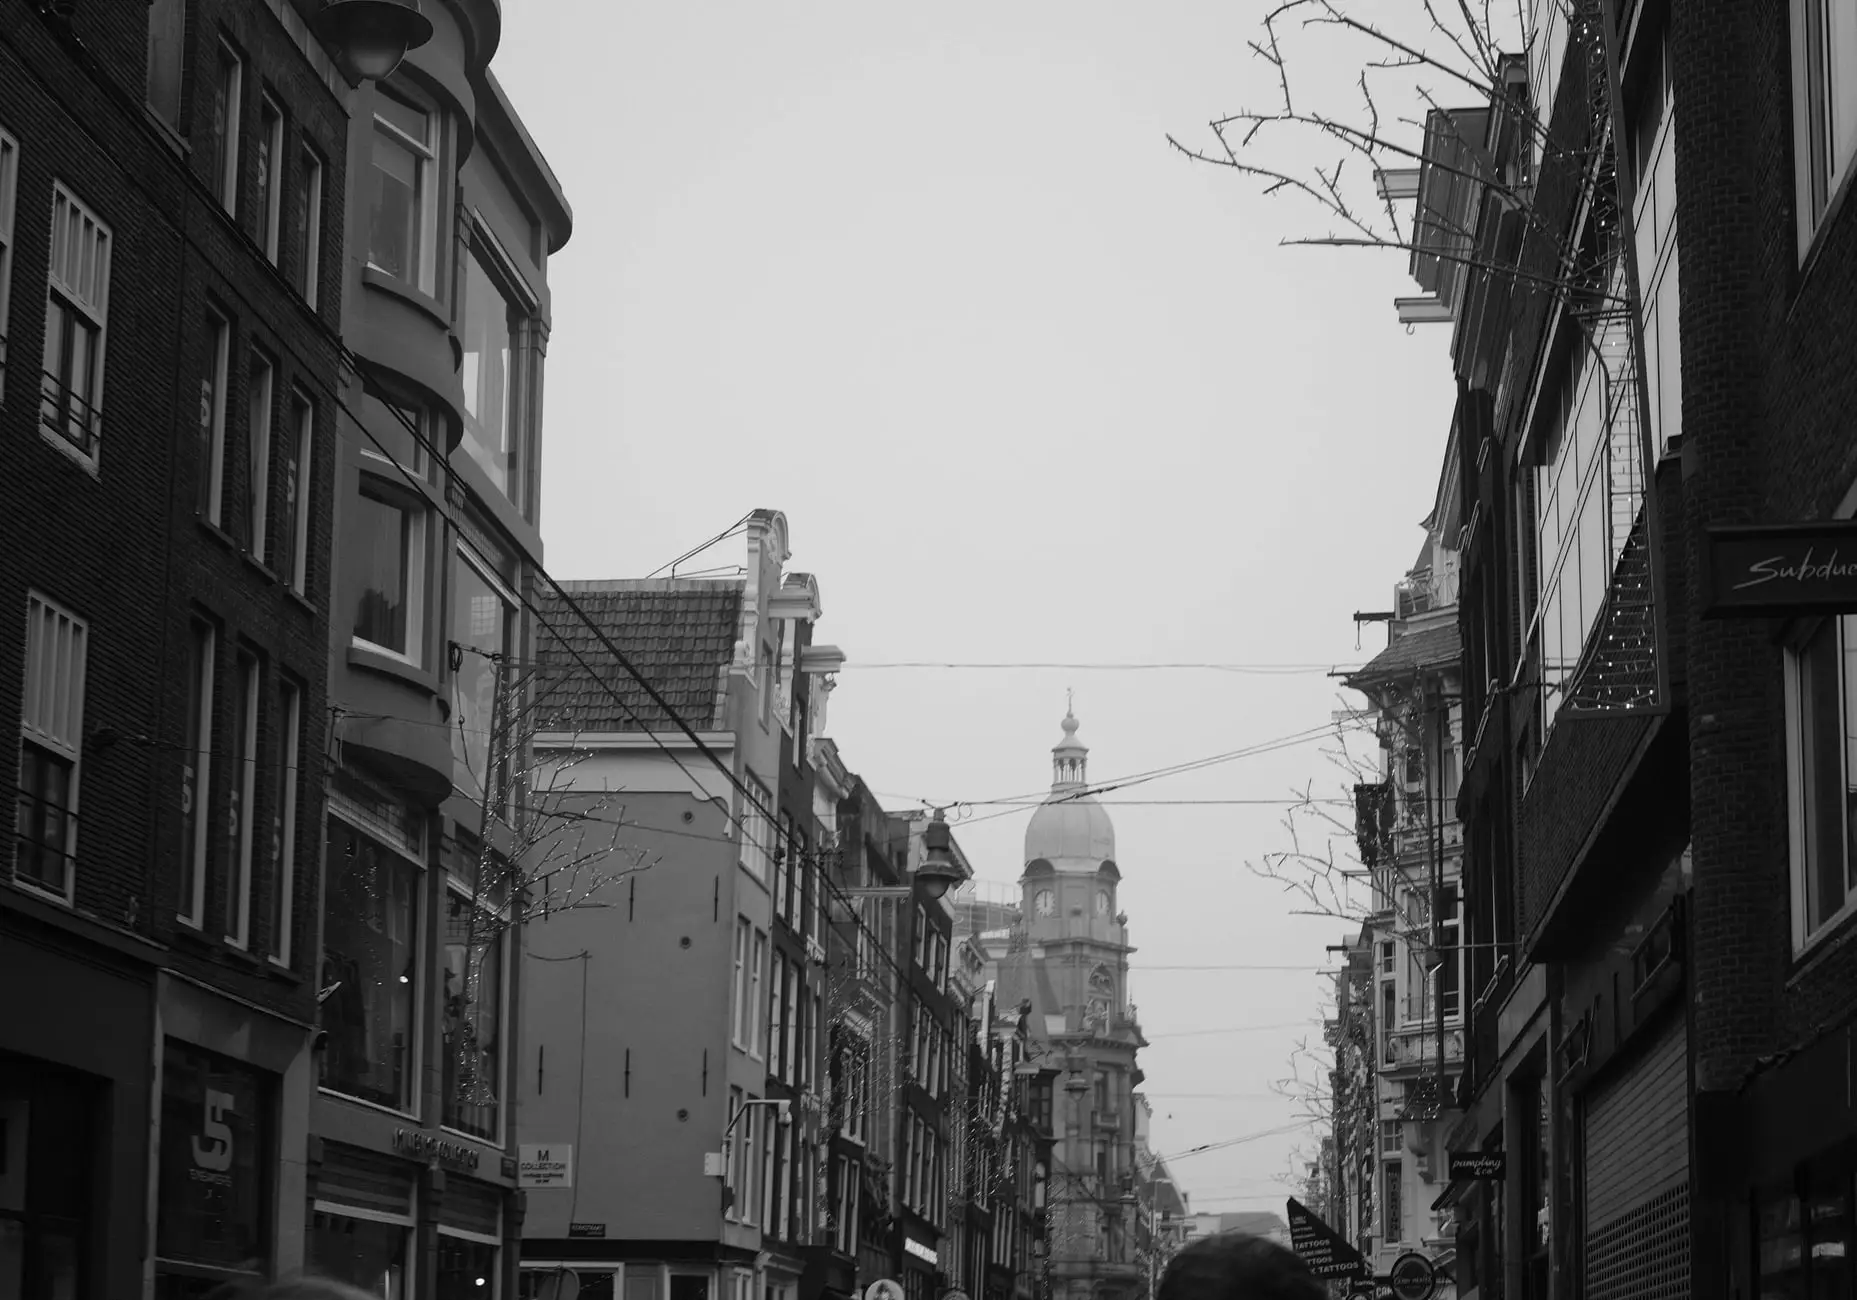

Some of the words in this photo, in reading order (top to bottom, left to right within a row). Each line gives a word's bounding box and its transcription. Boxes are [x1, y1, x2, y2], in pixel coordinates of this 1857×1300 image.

[538, 1150, 550, 1161] M
[520, 1162, 567, 1170] COLLECTION
[1294, 1239, 1331, 1251] TATTOOS
[1318, 1261, 1359, 1274] TATTOOS
